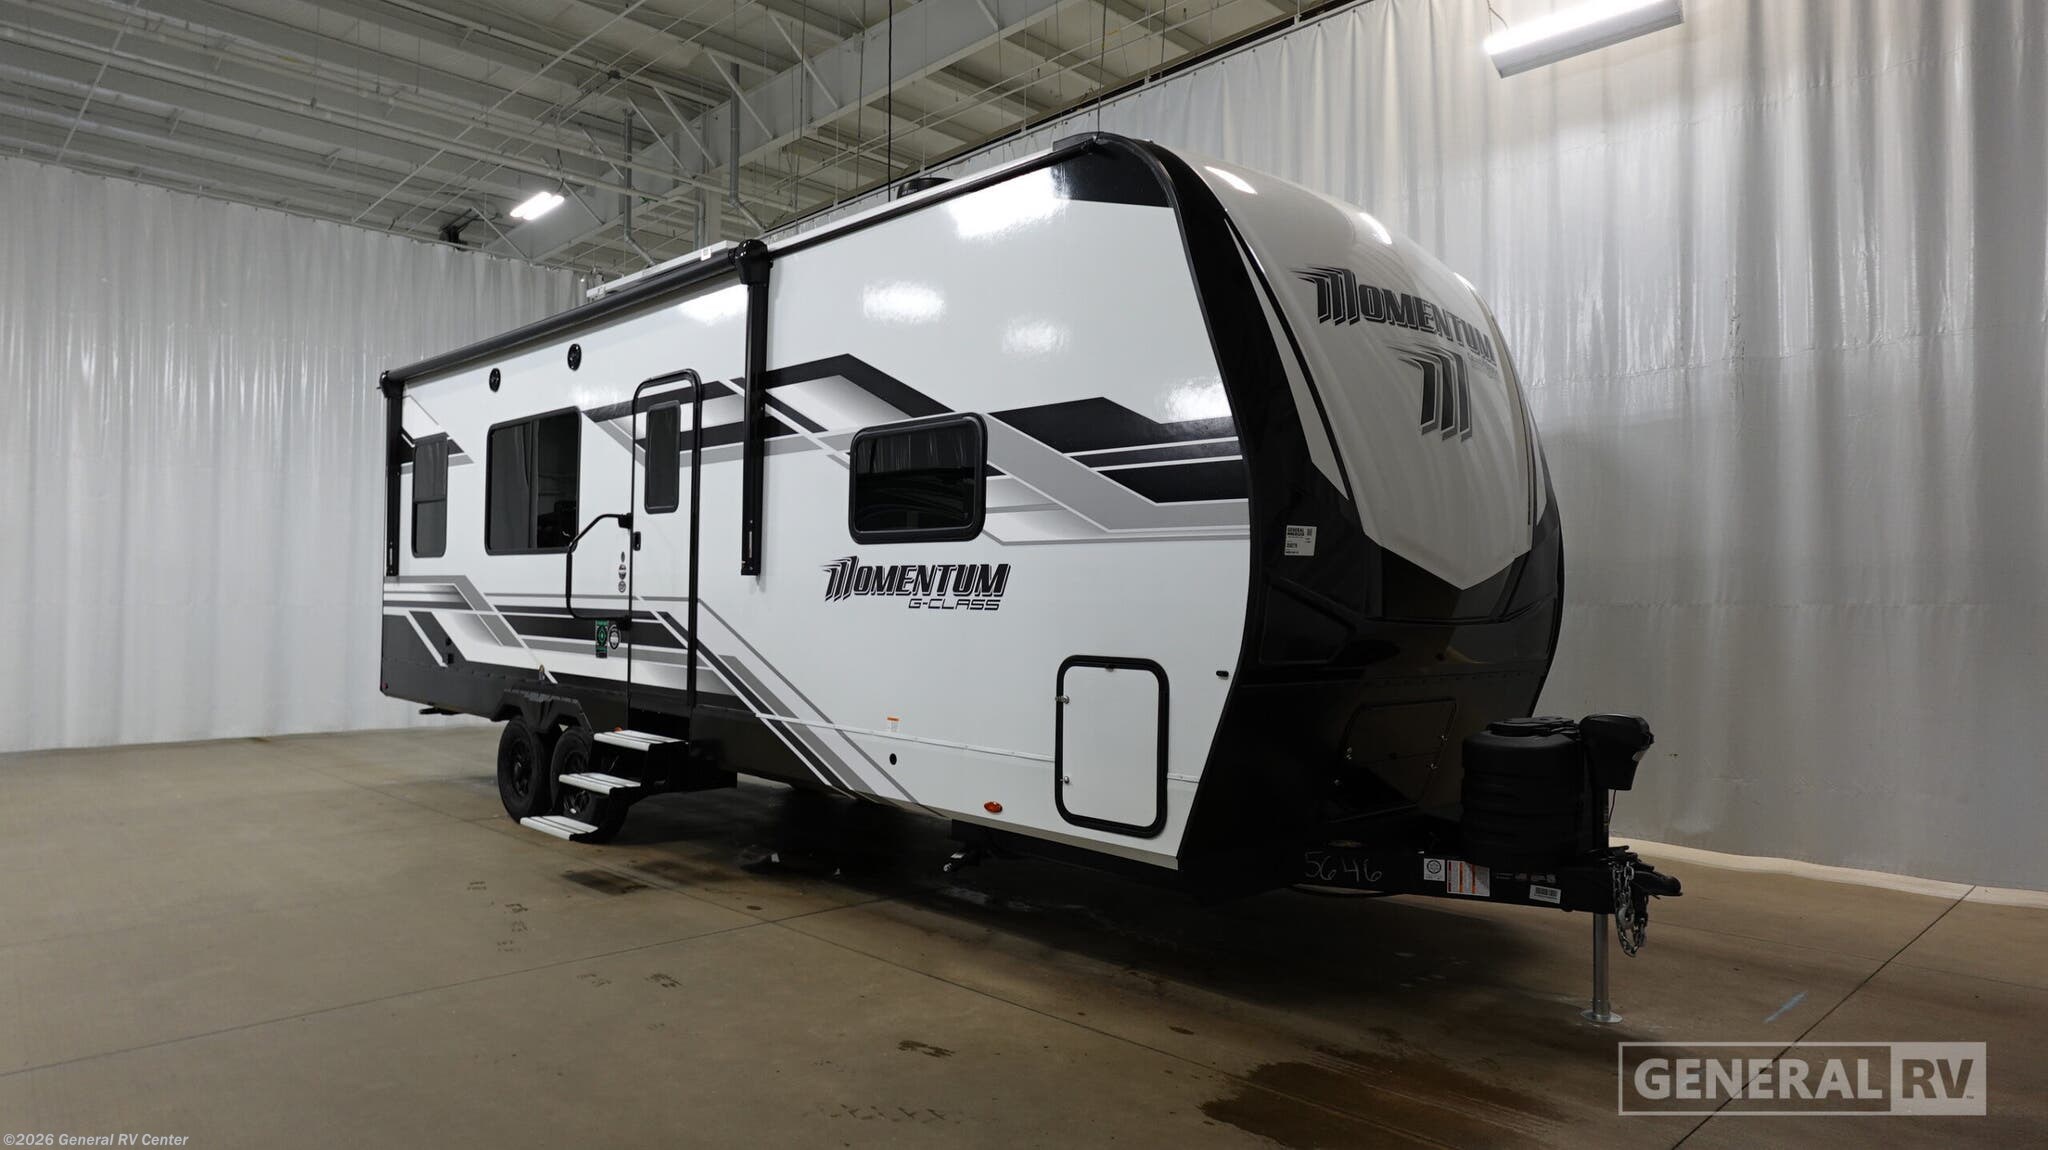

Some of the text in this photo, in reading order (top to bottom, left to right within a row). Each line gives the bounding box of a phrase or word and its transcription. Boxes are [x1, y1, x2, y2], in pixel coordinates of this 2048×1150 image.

[1289, 265, 1498, 368] MOMENTUM
[819, 555, 1012, 602] MOMENTUM
[908, 598, 1001, 611] G-CLASS
[1304, 850, 1383, 883] 5646
